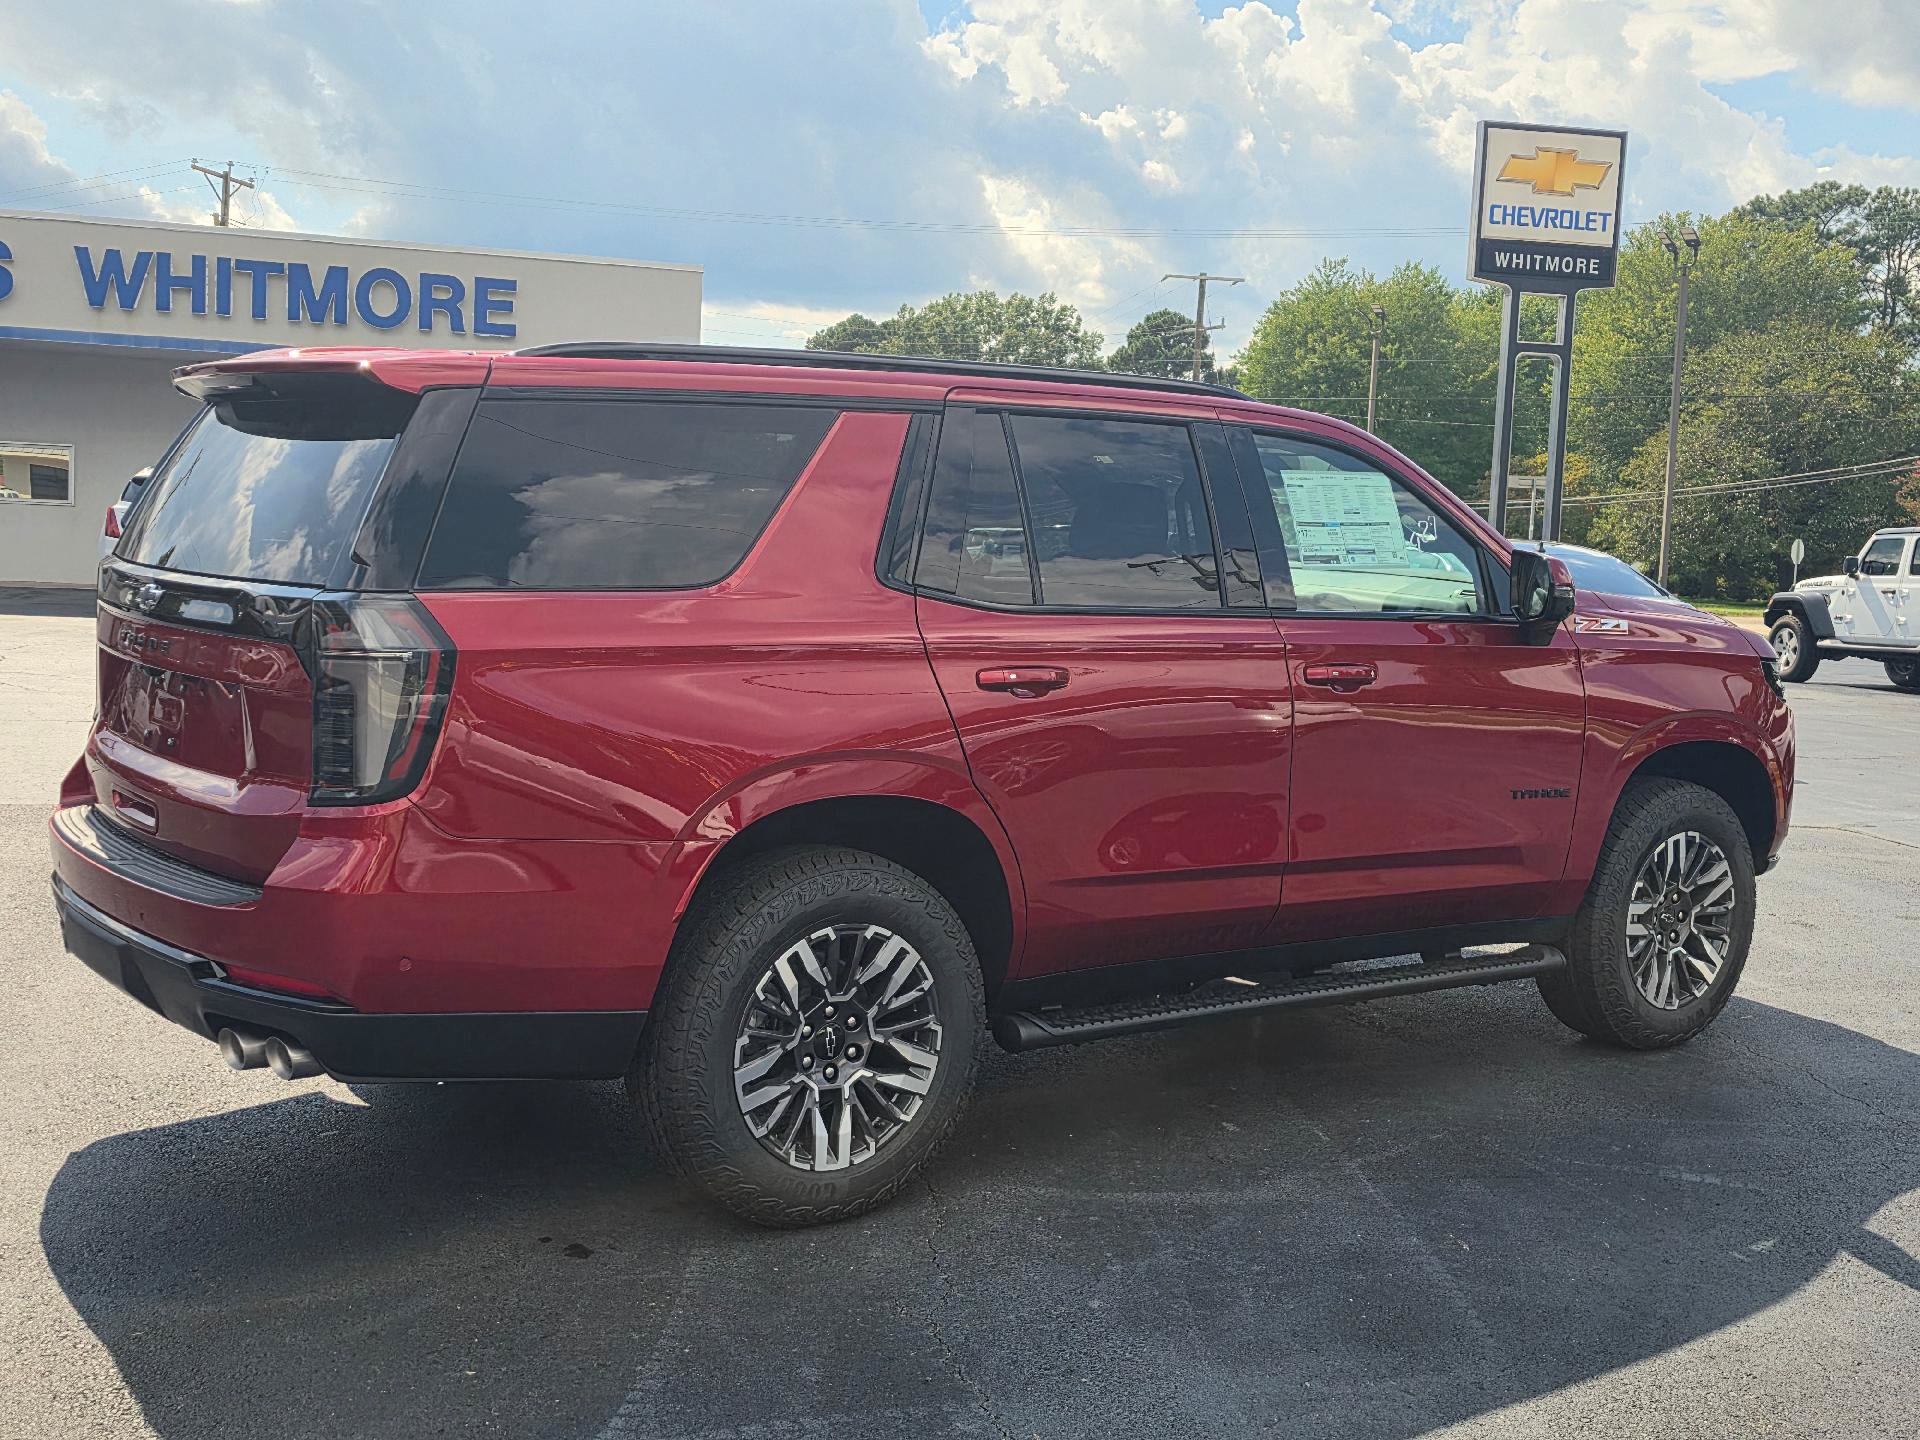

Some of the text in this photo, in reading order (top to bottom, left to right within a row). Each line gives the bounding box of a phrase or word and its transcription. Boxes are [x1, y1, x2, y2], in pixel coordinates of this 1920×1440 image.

[1489, 203, 1612, 232] CHEVROLET
[1494, 251, 1600, 275] WHITMORE
[73, 245, 518, 337] WHITMORE
[1510, 788, 1571, 800] TAHOE
